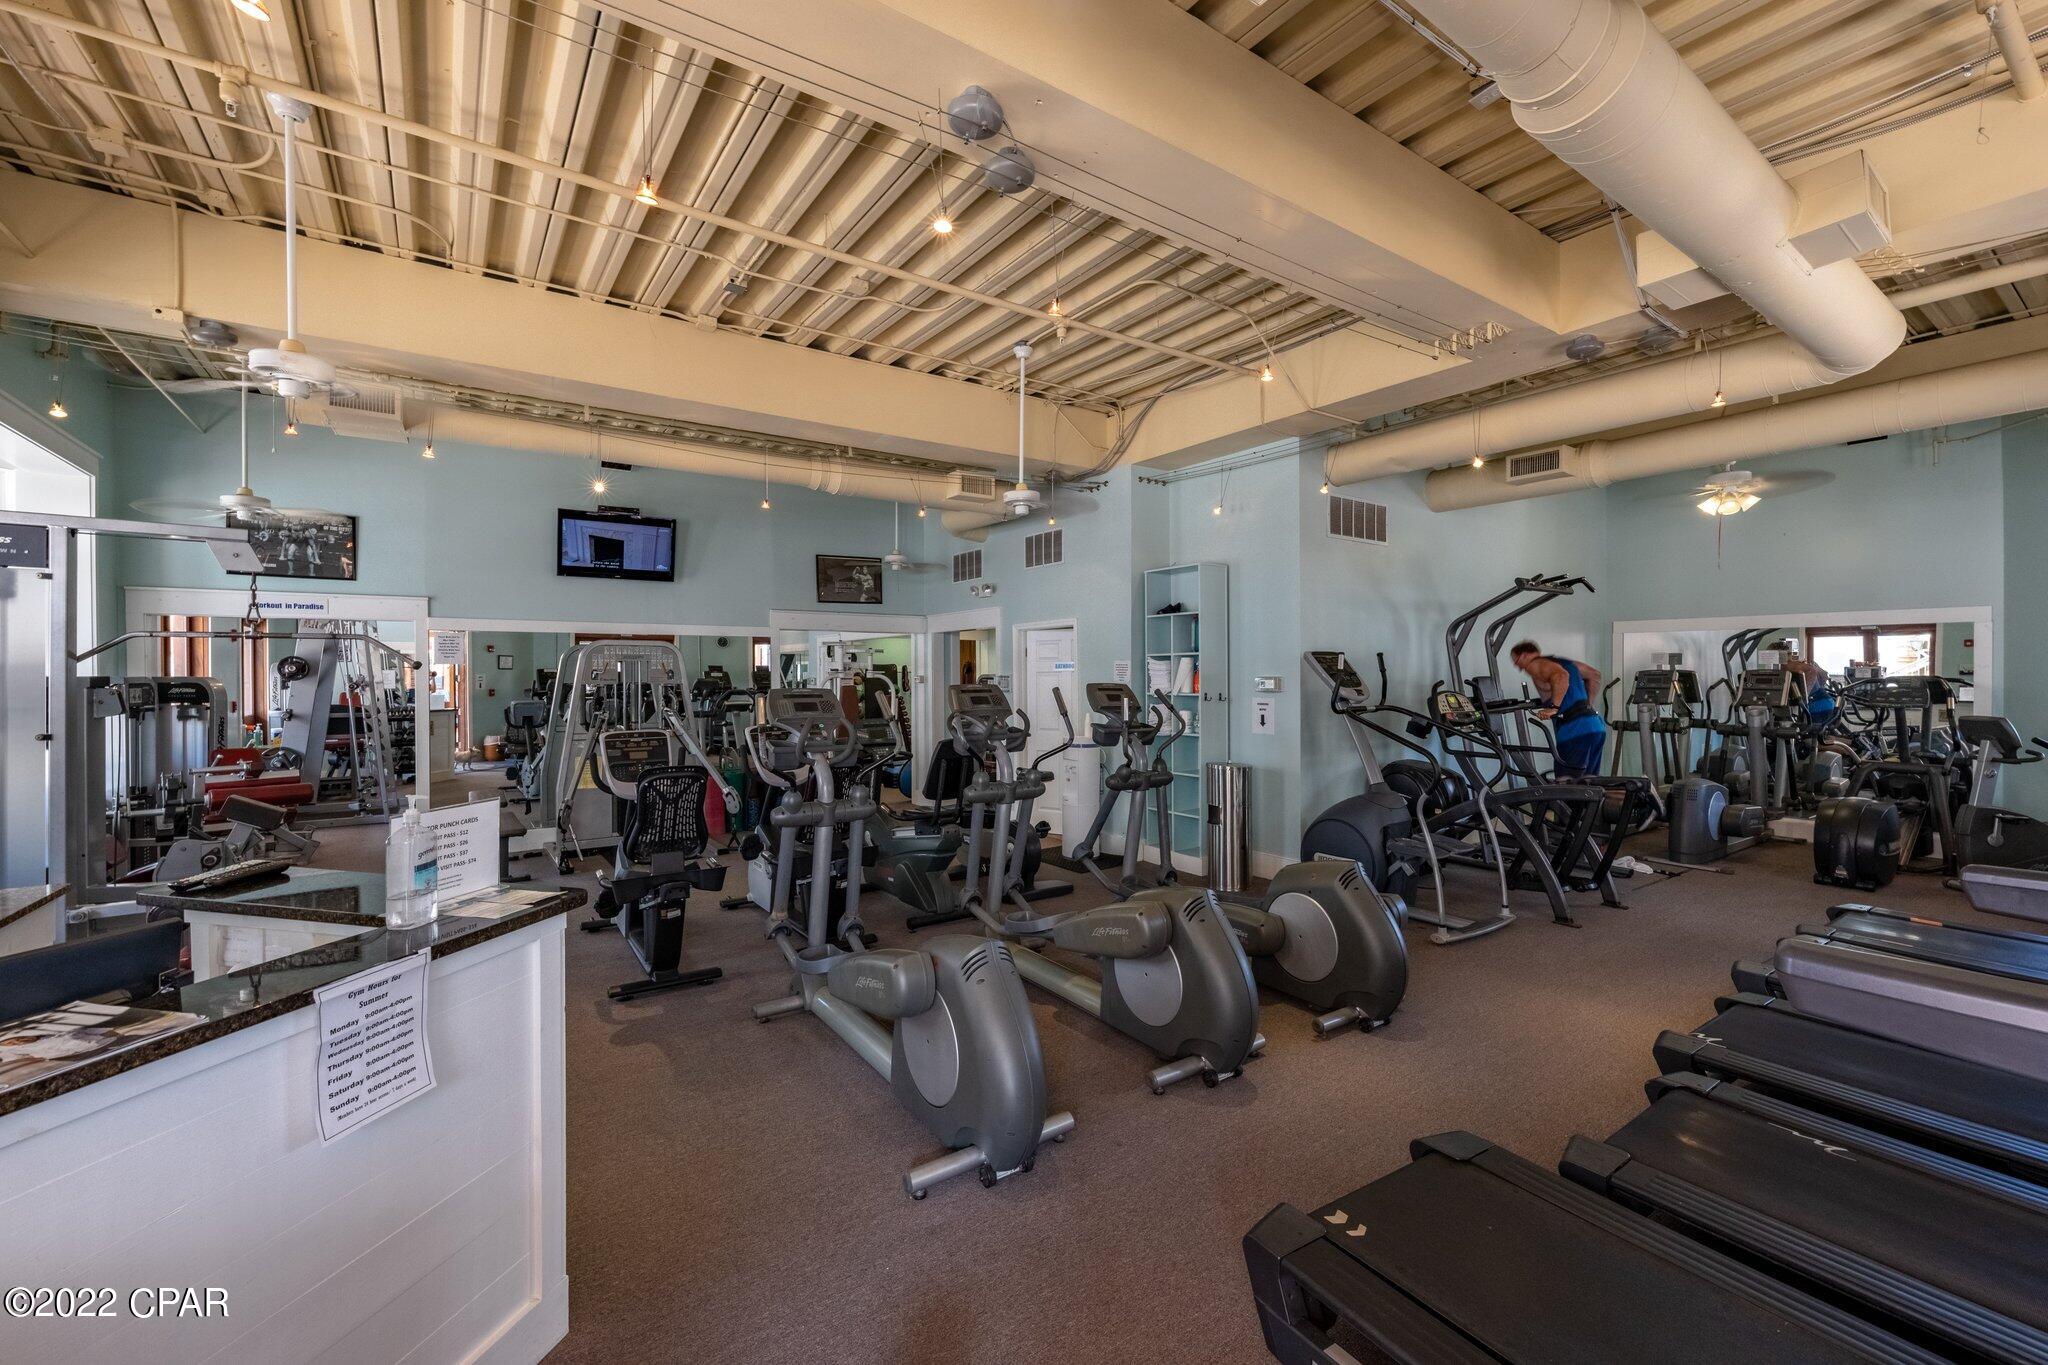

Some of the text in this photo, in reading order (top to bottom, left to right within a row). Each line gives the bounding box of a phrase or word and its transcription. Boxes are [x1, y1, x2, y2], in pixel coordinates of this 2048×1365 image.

[293, 602, 324, 610] Paradise
[440, 820, 460, 829] PUNCH
[460, 816, 479, 827] CARDS
[348, 974, 402, 999] Gym Hours for
[359, 992, 389, 1008] Summer
[329, 1007, 414, 1048] Tuesday 9:00am-4:00pm
[330, 995, 412, 1036] Monday 9:00am-4:00pm
[327, 1029, 413, 1072] Thursday 9:00am-4:00pm
[328, 1016, 414, 1059] Wednesday 9:00am-4:00pm
[328, 1041, 414, 1086] Friday 9:00am-4:00pm
[329, 1053, 414, 1099] Saturday 9:00am-4:00pm
[330, 1066, 416, 1113] Sunday 9:00am-4:00pm
